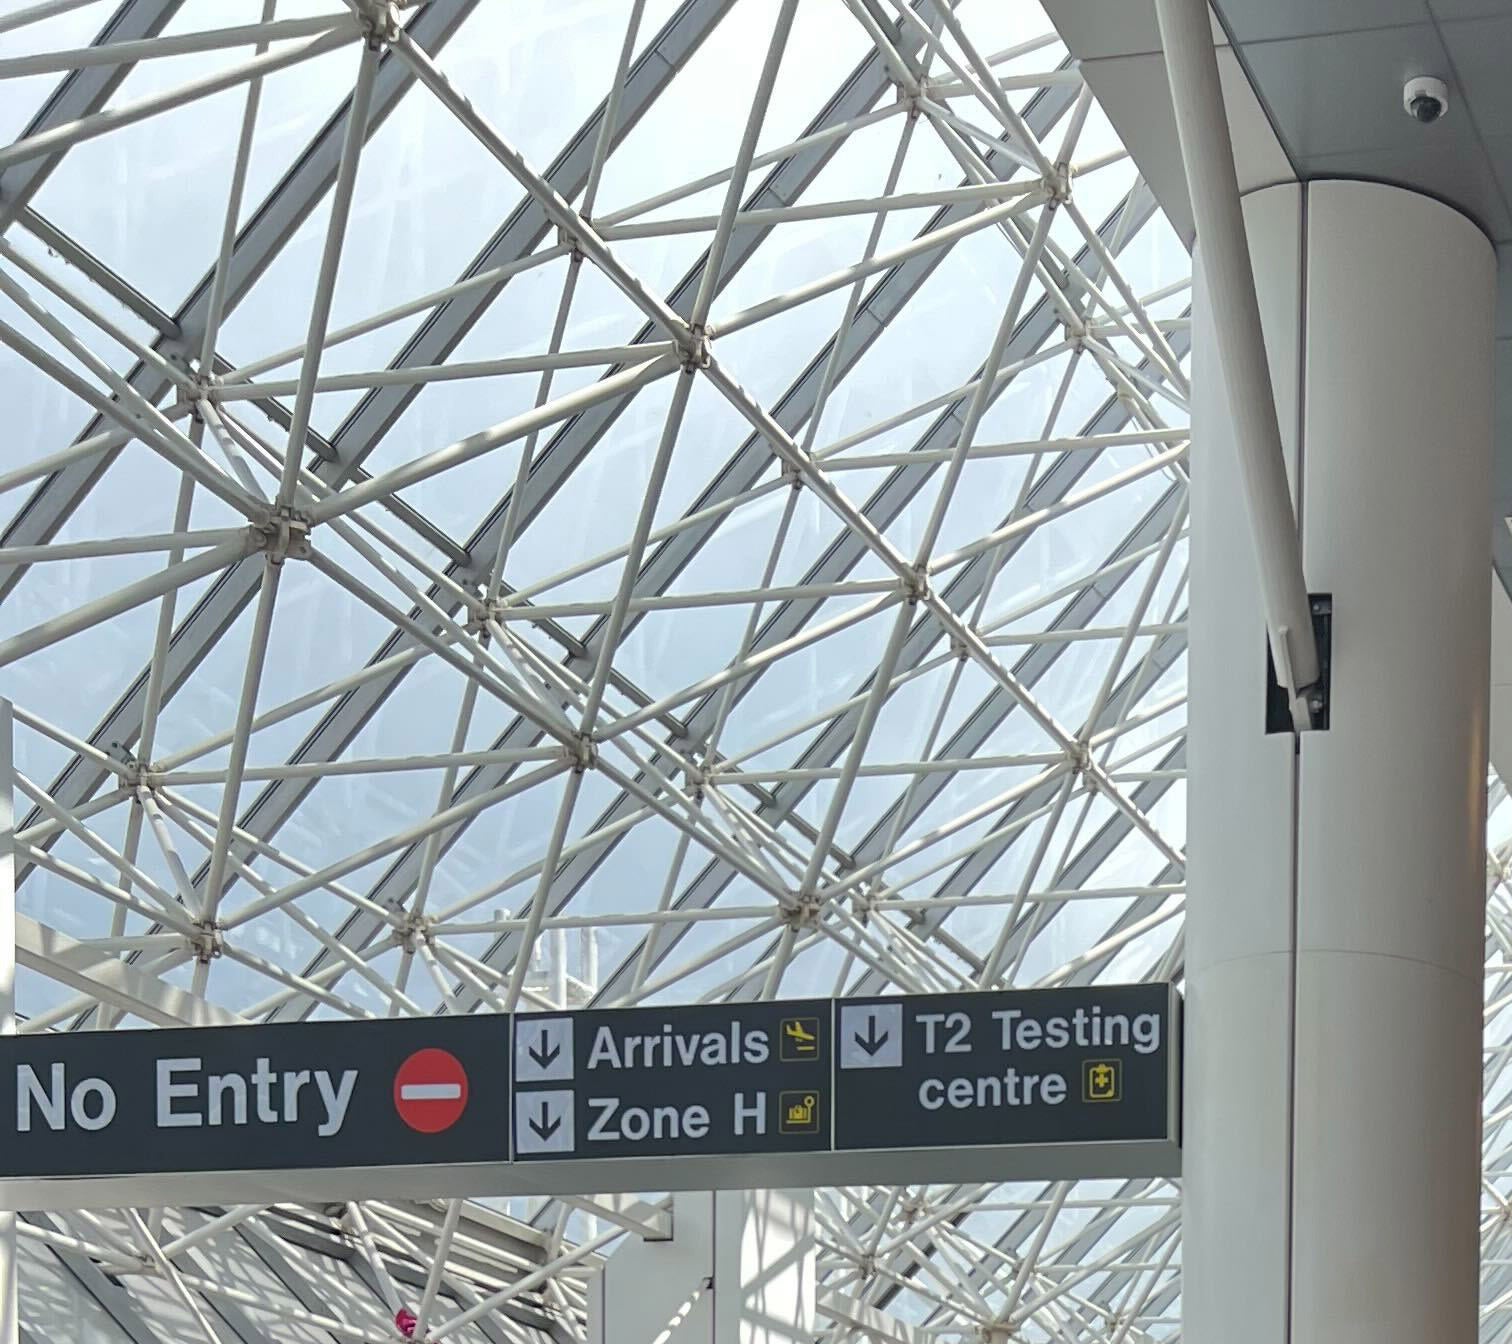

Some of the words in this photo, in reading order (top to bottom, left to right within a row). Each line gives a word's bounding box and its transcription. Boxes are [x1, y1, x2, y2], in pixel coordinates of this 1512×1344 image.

[587, 1021, 770, 1069] Arrivals
[915, 1011, 973, 1054] T2
[992, 1006, 1162, 1054] Testing
[16, 1062, 117, 1133] No
[155, 1057, 358, 1137] Entry
[918, 1067, 1068, 1110] centre
[587, 1096, 710, 1141] Zone
[734, 1091, 767, 1135] H
